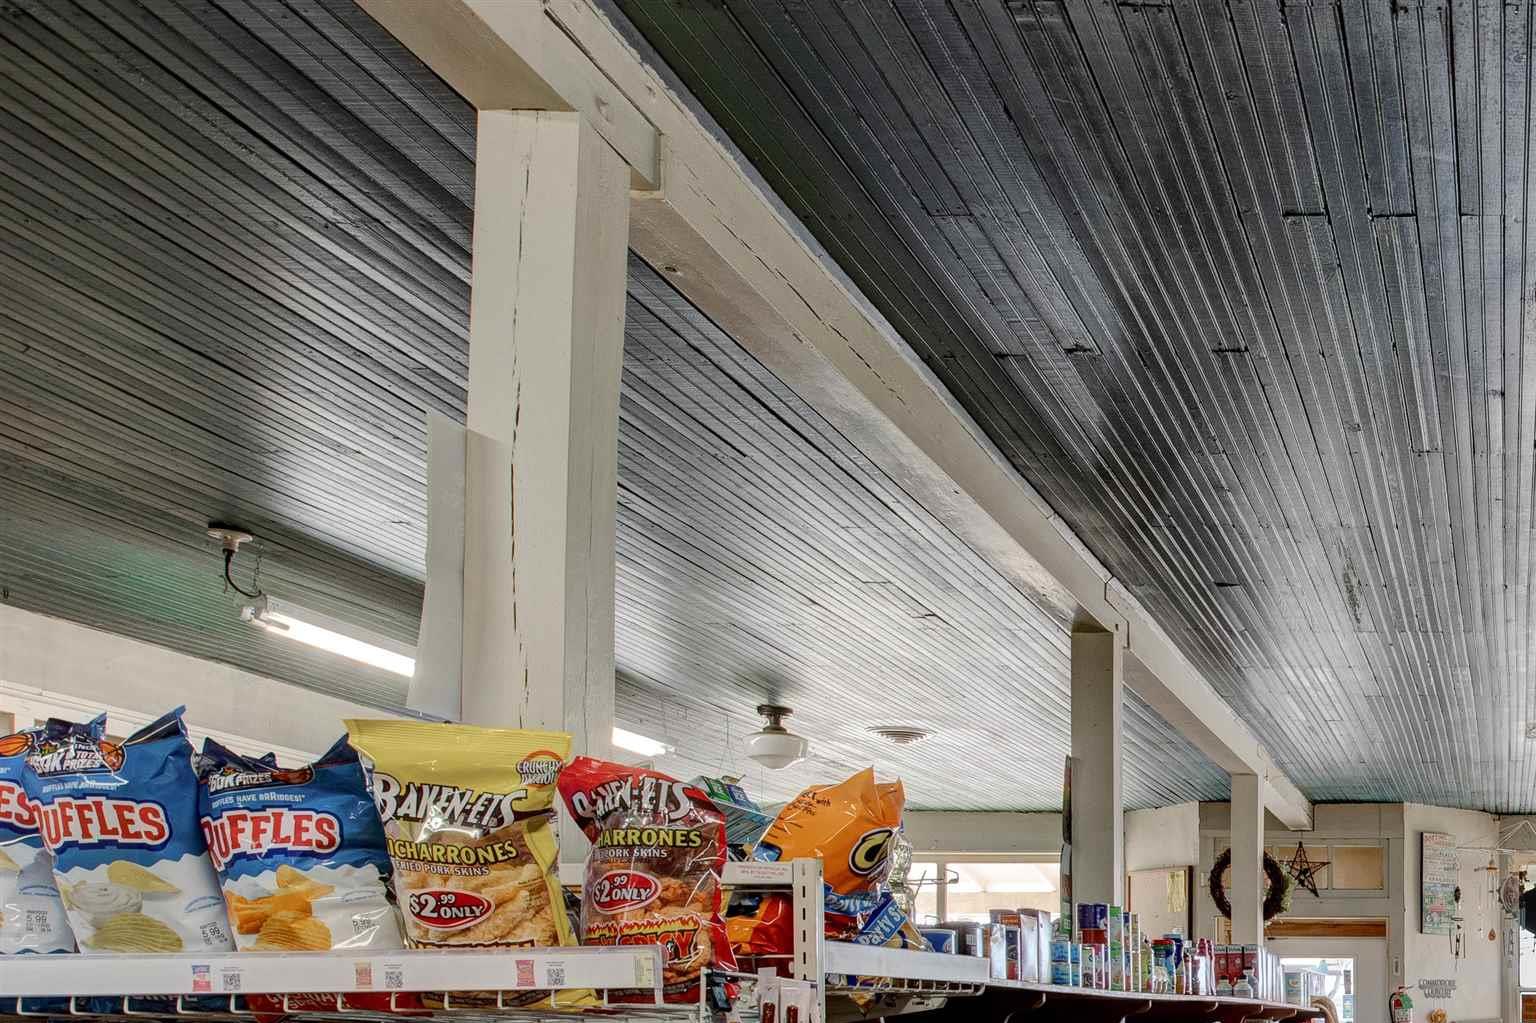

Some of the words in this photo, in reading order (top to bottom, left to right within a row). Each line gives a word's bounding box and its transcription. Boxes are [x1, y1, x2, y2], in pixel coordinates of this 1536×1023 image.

[516, 759, 562, 774] CRUNCHY
[201, 811, 337, 867] RUFFLES
[387, 839, 517, 867] ICHARRONES
[608, 850, 629, 858] ORK
[633, 849, 668, 858] SKINS
[424, 864, 451, 875] PORK
[455, 866, 490, 877] SKINS
[611, 886, 650, 901] ONLY
[440, 904, 485, 919] ONLY
